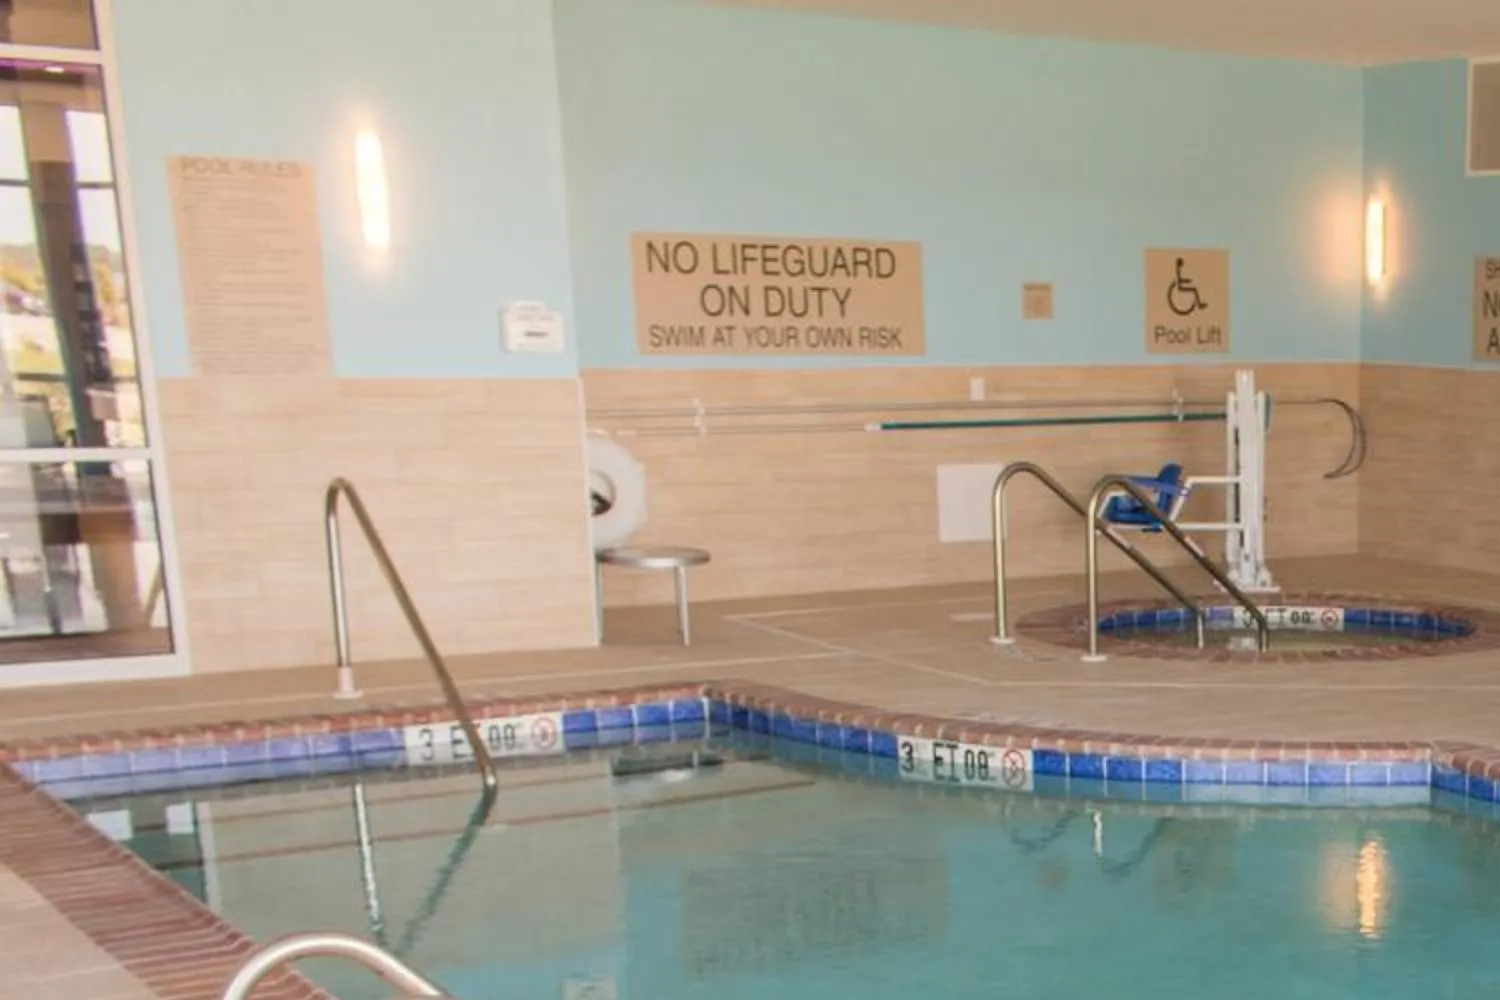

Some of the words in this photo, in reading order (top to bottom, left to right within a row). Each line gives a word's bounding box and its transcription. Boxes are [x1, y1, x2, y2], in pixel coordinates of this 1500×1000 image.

[646, 240, 699, 275] NO
[712, 242, 896, 279] LIFEGUARD
[700, 284, 751, 318] ON
[764, 286, 852, 318] DUTY
[649, 324, 704, 348] SWIM
[711, 325, 736, 348] AT
[743, 325, 798, 349] YOUR
[805, 325, 852, 348] OWN
[859, 326, 903, 349] RISK
[1154, 325, 1191, 345] Pool
[1197, 325, 1222, 345] Lift
